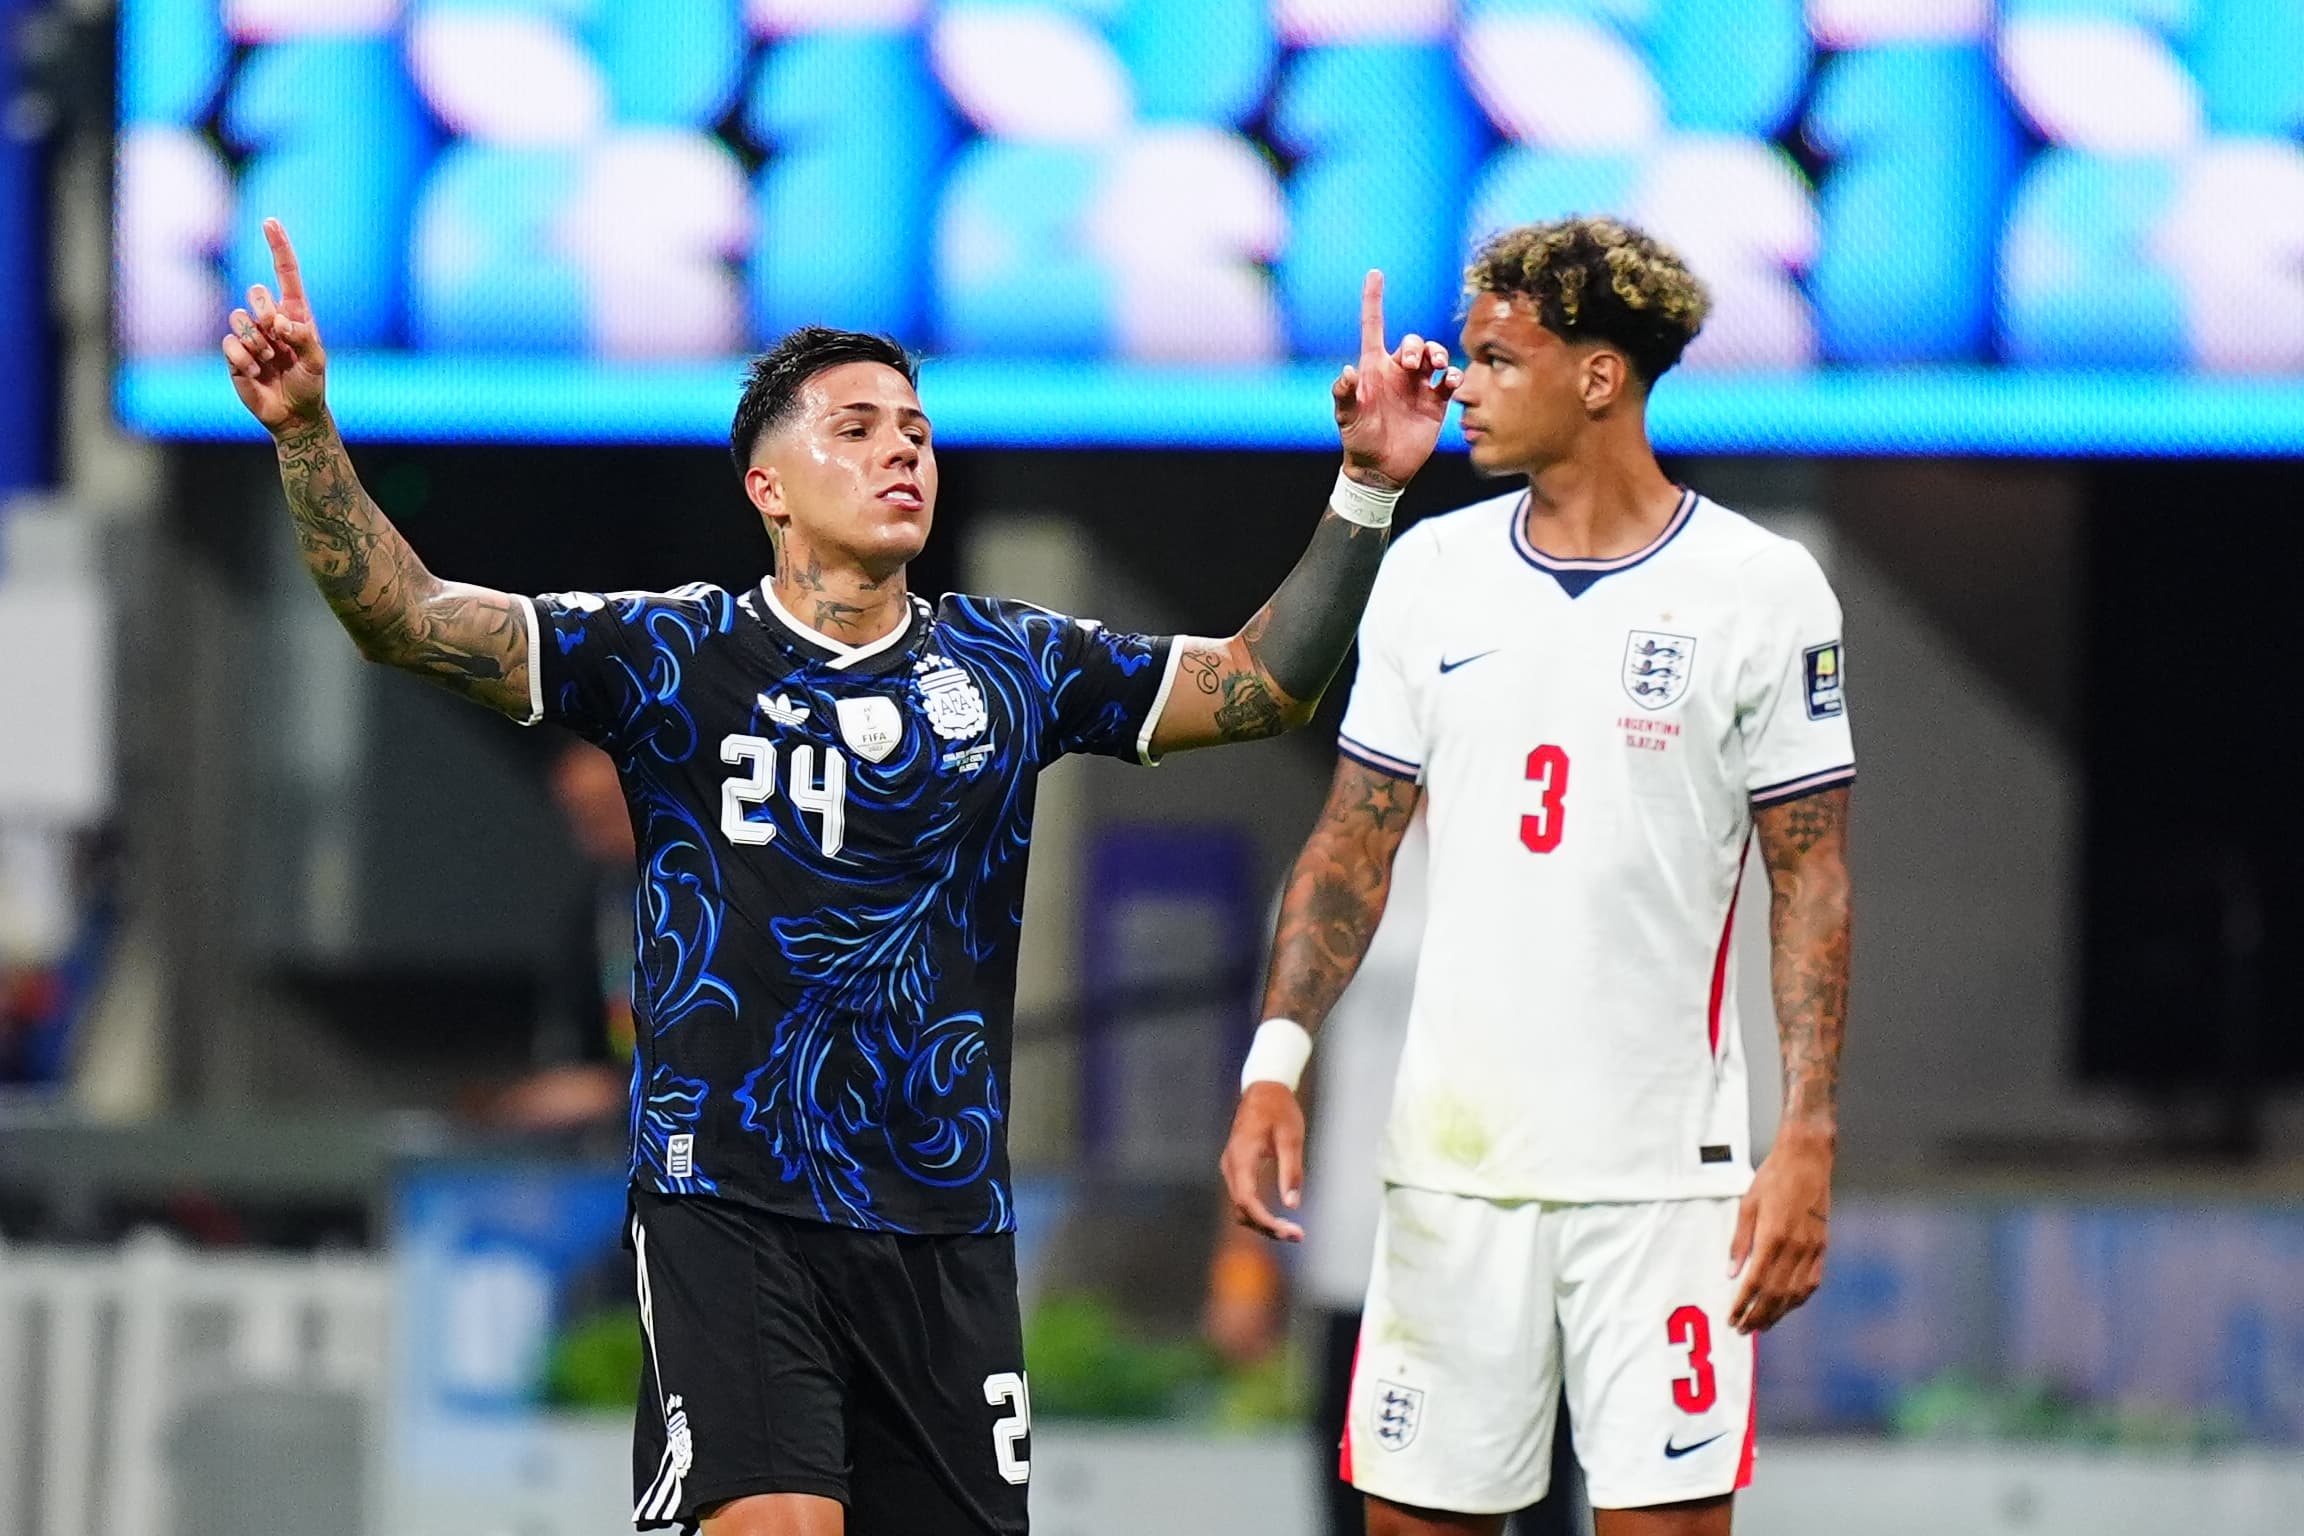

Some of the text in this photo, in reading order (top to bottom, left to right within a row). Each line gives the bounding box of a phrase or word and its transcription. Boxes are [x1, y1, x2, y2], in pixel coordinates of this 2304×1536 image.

[862, 732, 887, 743] FIFA
[720, 733, 847, 858] 24
[1520, 744, 1570, 854] 3
[1667, 1305, 1717, 1415] 3
[983, 1370, 1031, 1485] 2
